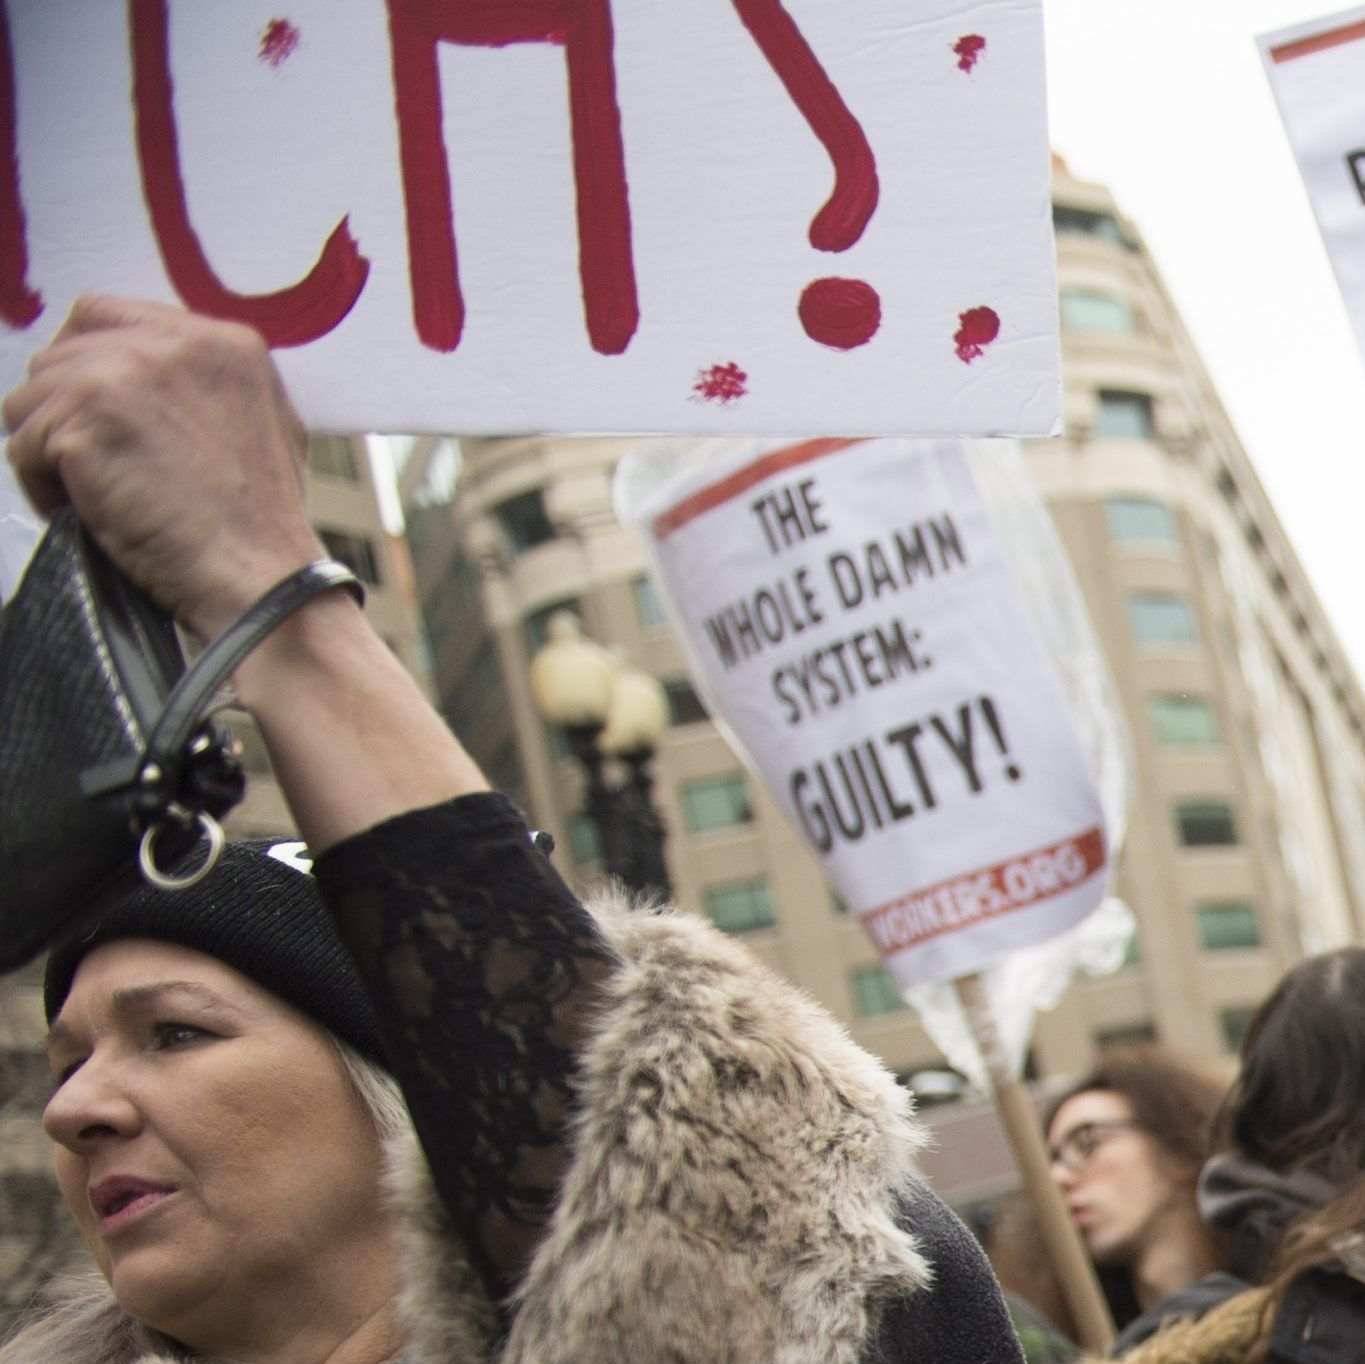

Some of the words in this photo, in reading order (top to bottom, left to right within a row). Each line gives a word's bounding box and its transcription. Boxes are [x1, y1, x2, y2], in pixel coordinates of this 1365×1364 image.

[752, 480, 828, 554] THE
[704, 568, 824, 669] WHOLE
[828, 511, 967, 609] DAMN
[772, 616, 934, 725] SYSTEM:
[788, 696, 1022, 854] GUILTY!
